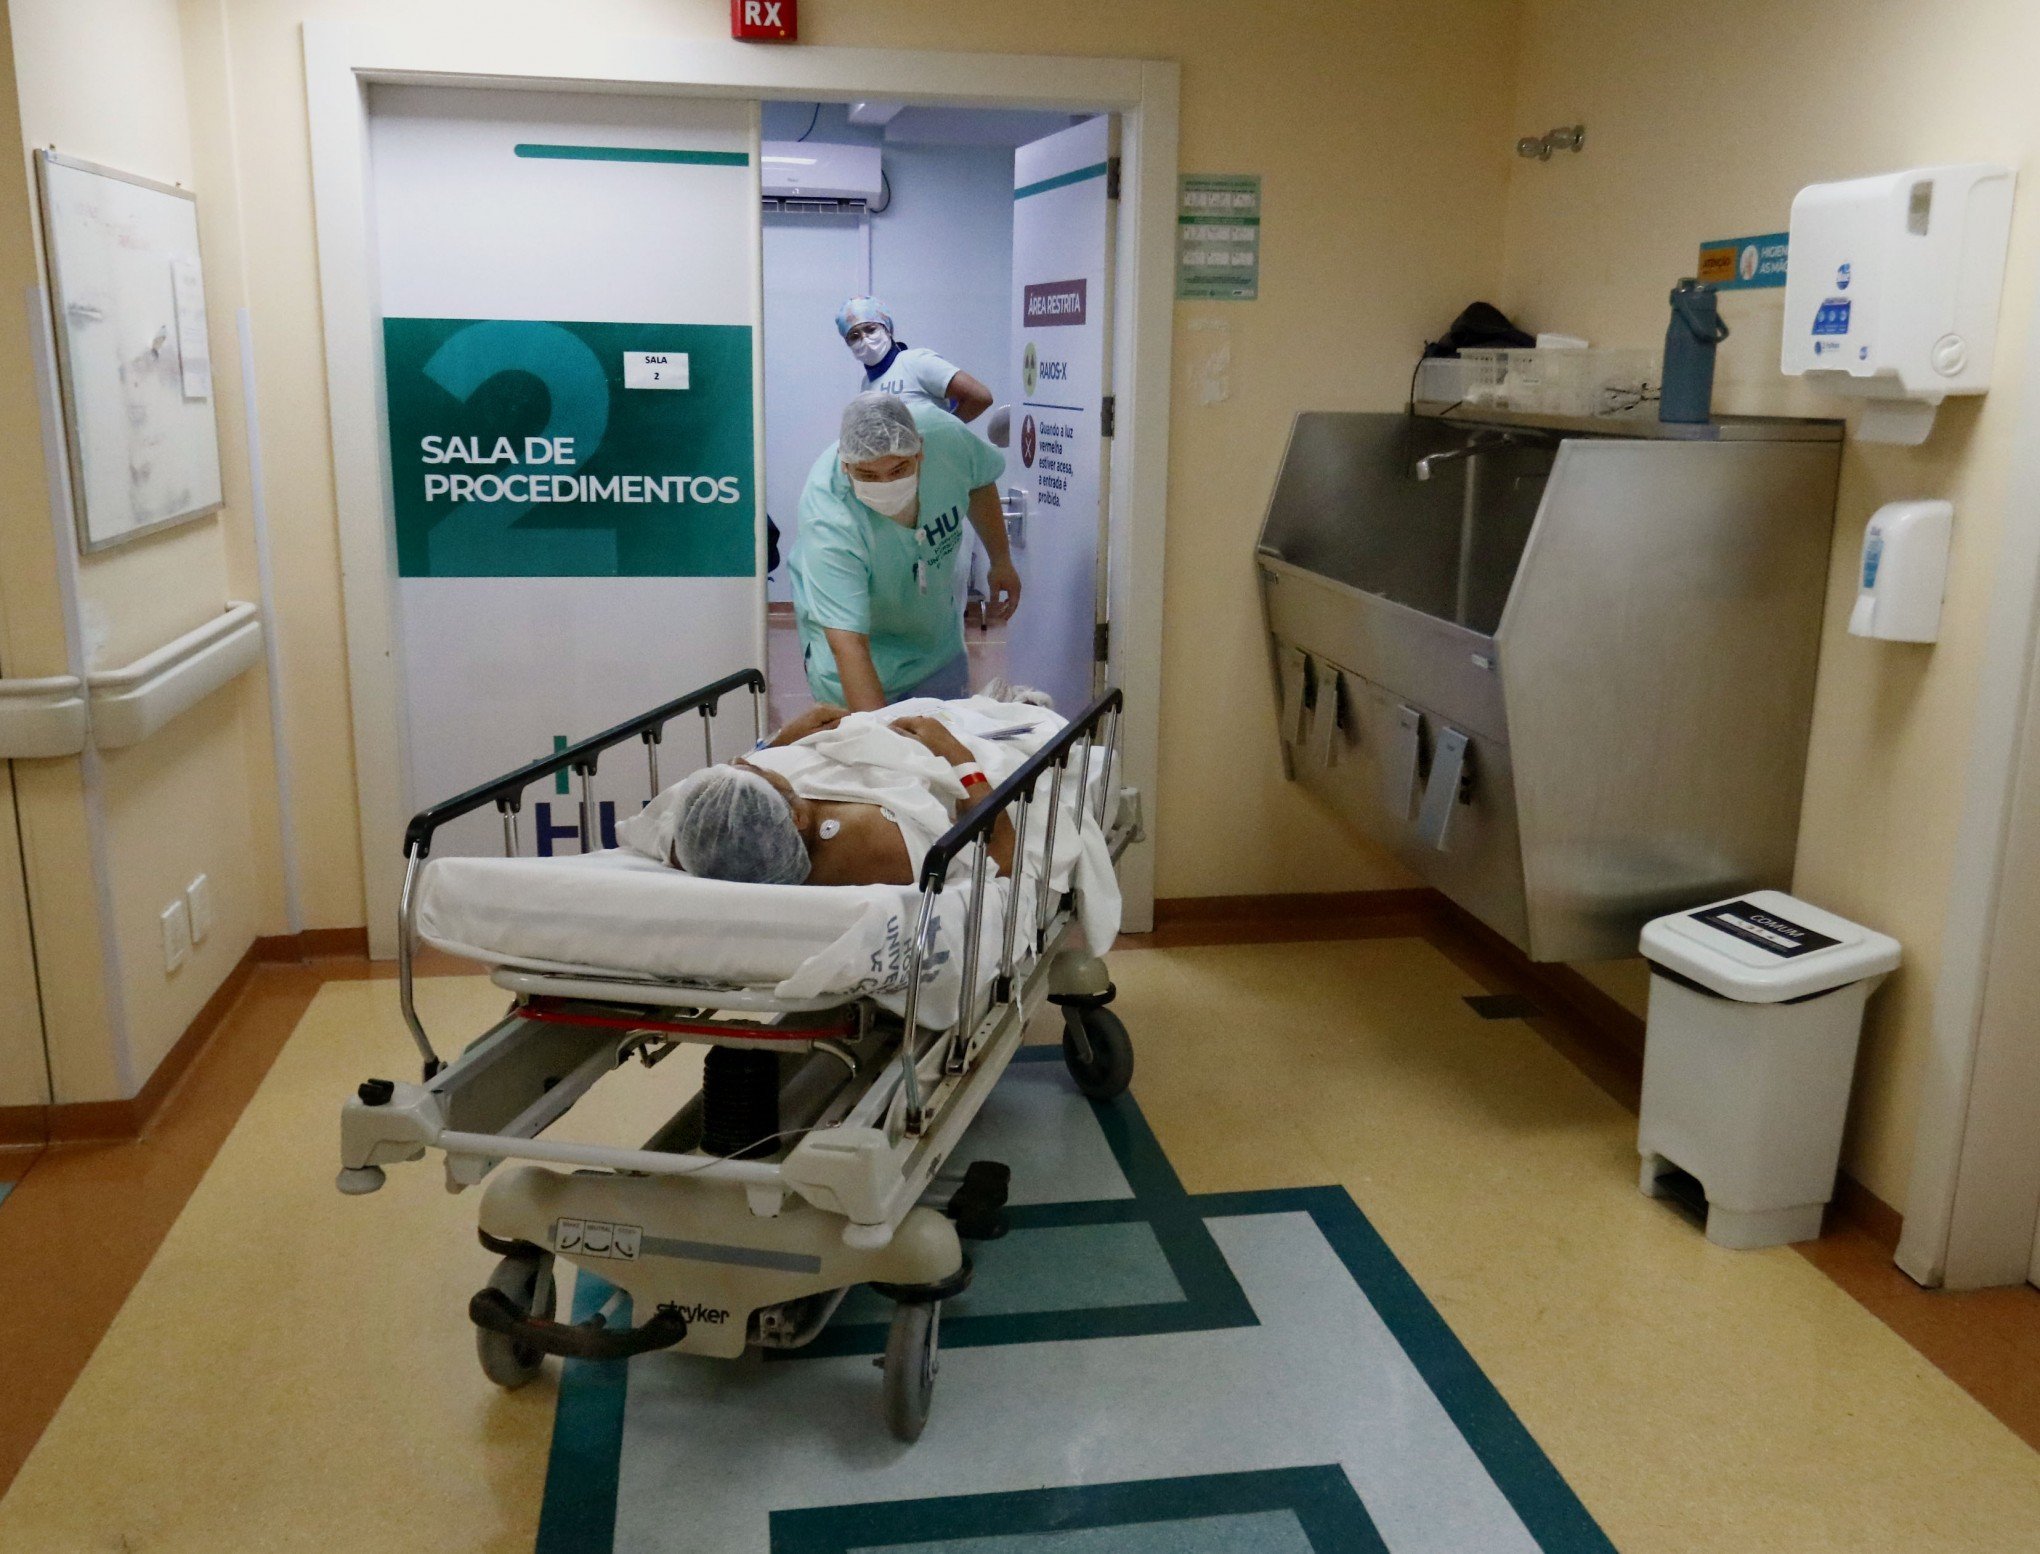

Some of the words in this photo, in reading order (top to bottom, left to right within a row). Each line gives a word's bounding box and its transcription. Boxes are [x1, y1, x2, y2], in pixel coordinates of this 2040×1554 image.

[745, 1, 782, 27] RX
[1028, 293, 1046, 315] ÁREA
[1047, 293, 1081, 314] RESTRITA
[645, 356, 668, 365] SALA
[653, 372, 660, 380] 2
[1040, 362, 1067, 380] RAIOS-X
[1040, 422, 1060, 437] Quando
[1065, 423, 1073, 438] luz
[420, 435, 519, 464] SALA
[524, 437, 576, 465] DE
[1039, 440, 1062, 454] vermelha
[1039, 457, 1056, 470] estiver
[1056, 461, 1073, 477] acesa,
[424, 473, 741, 504] PROCEDIMENTOS
[1042, 475, 1062, 490] entrada
[1062, 477, 1067, 491] é
[1038, 490, 1060, 507] proibida.
[924, 506, 959, 546] HU
[1750, 914, 1804, 938] COMUM
